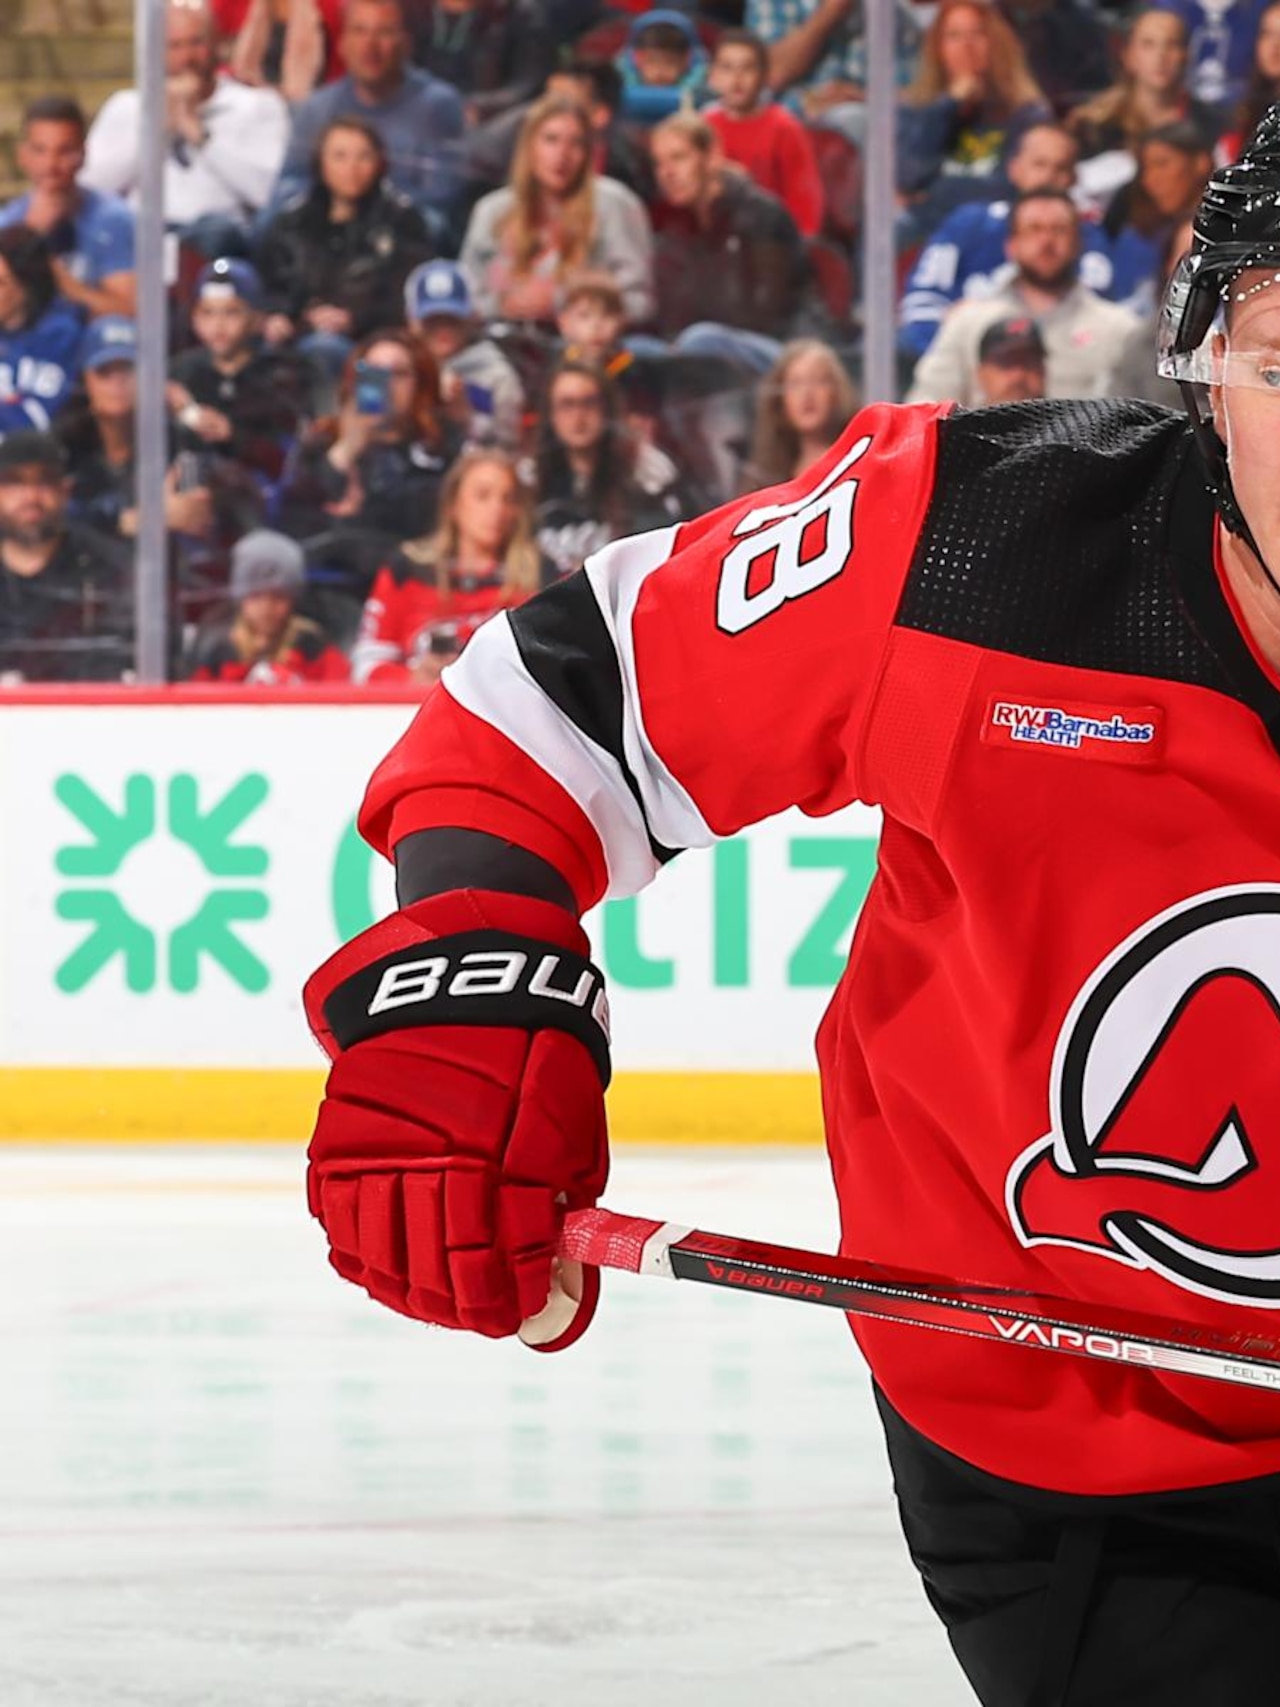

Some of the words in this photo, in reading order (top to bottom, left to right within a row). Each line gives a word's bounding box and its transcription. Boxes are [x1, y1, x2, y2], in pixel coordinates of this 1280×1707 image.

[716, 435, 873, 636] 18
[1012, 726, 1081, 747] HEALTH
[987, 1314, 1156, 1365] VAPOR
[1223, 1365, 1260, 1381] FEEL
